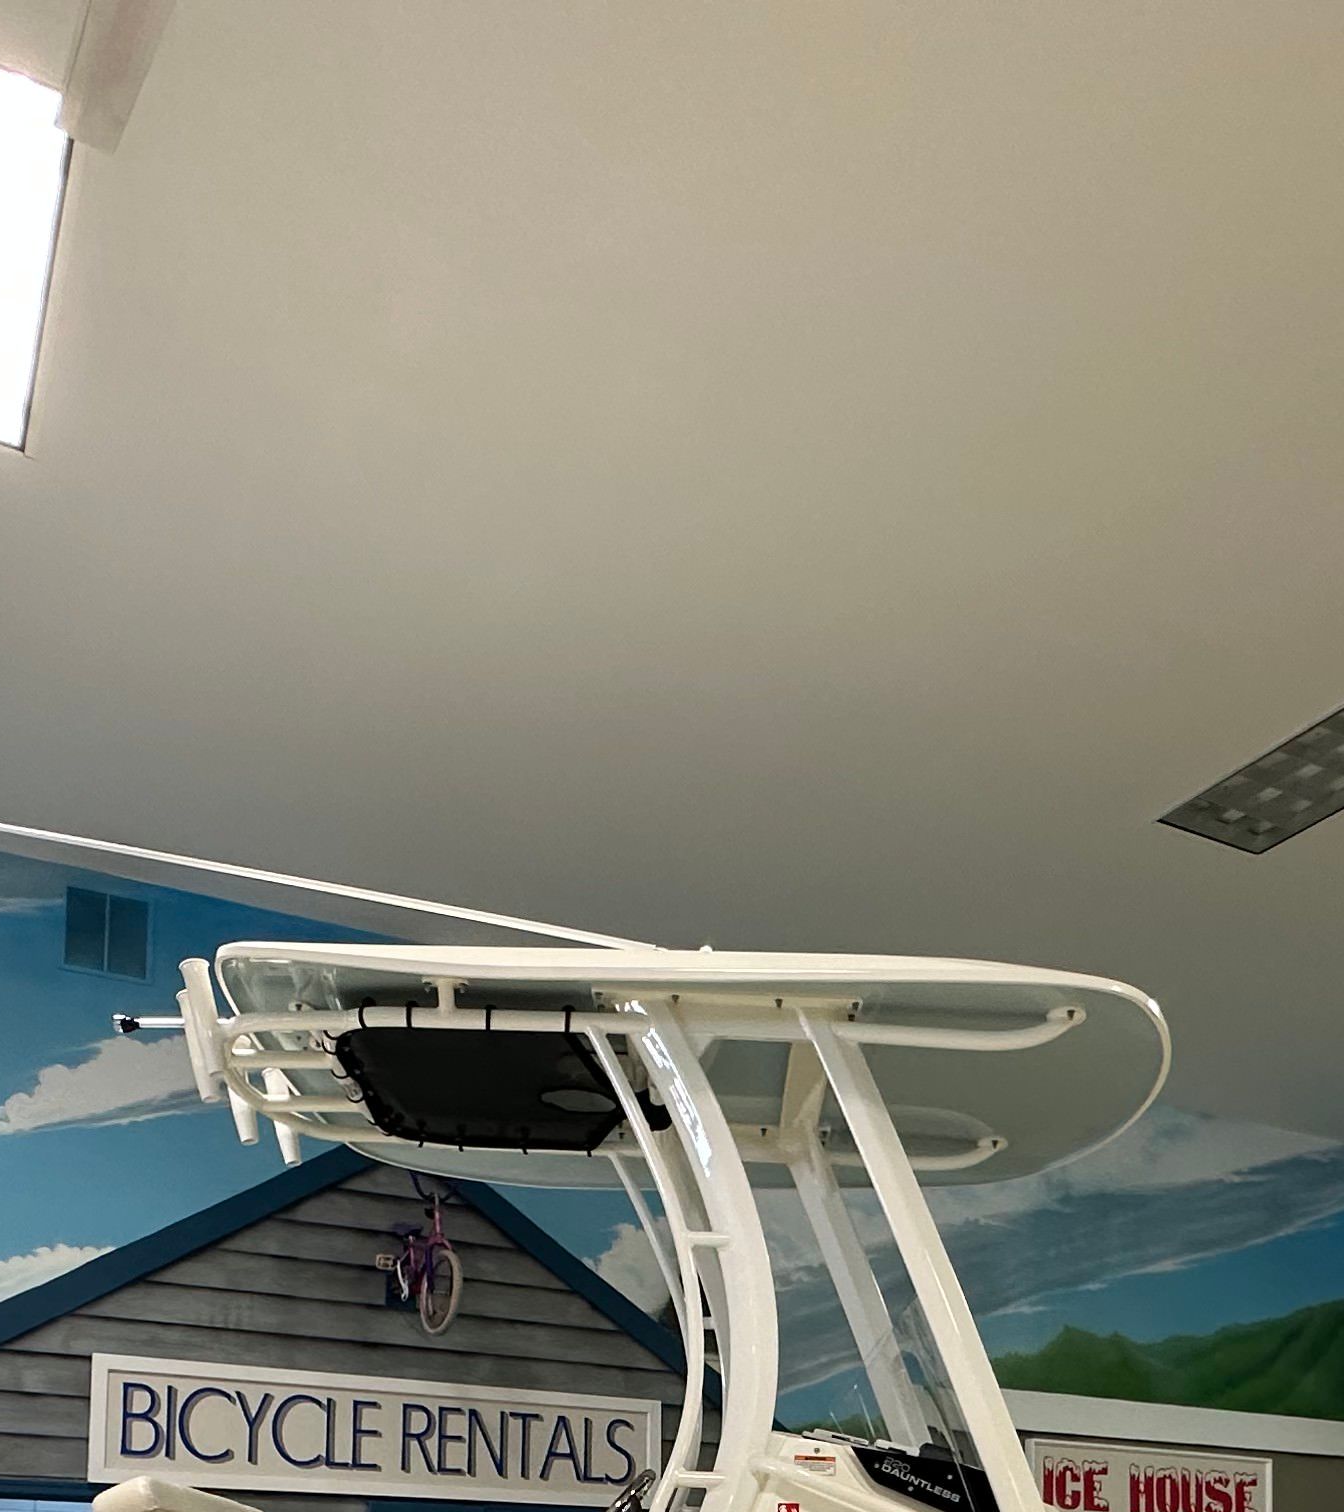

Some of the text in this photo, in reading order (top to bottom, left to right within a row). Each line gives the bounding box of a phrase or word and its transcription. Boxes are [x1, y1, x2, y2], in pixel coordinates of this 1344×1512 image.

[119, 1381, 638, 1487] BICYCLE RENTALS
[881, 1463, 961, 1503] DAUNTLESS
[1043, 1456, 1109, 1512] ICE
